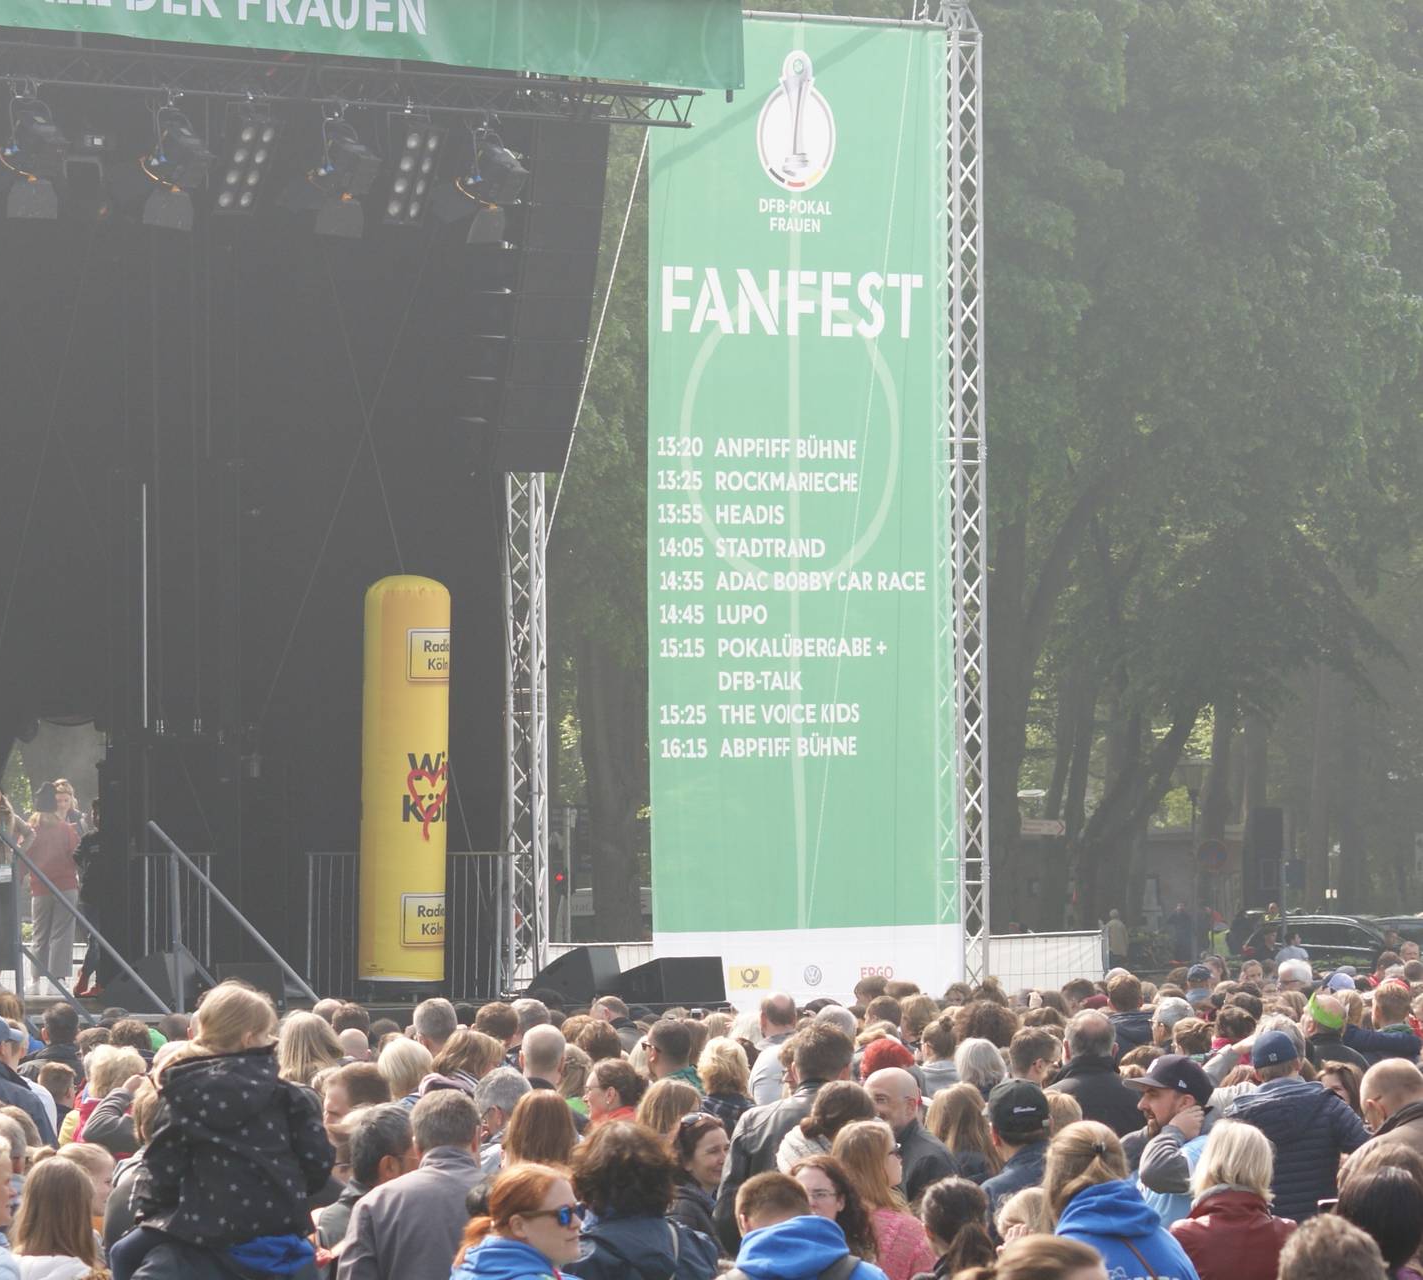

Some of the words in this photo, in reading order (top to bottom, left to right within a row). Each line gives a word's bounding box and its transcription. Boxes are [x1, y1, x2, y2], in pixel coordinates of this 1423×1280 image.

[759, 198, 832, 215] DFB-POKAL
[770, 217, 821, 232] FRAUEN
[662, 266, 923, 338] FANFEST
[657, 436, 703, 457] 13:20
[714, 438, 790, 458] ANPFIFF
[796, 435, 857, 459] BÜHNE
[657, 470, 703, 490] 13:25
[715, 471, 858, 492] ROCKMARIECHE
[657, 504, 703, 524] 13:55
[716, 504, 785, 525] HEADIS
[658, 537, 704, 557] 14:05
[715, 537, 826, 558] STADTRAND
[660, 571, 704, 591] 14:35
[716, 571, 768, 591] ADAC
[773, 571, 833, 592] BOBBY
[838, 571, 873, 592] CAR
[877, 571, 926, 591] RACE
[659, 604, 704, 624] 14:45
[717, 604, 768, 625] LUPO
[423, 638, 449, 653] Rad
[659, 638, 705, 658] 15:15
[717, 634, 872, 658] POKALÜBERGABE
[719, 671, 803, 691] DFB-TALK
[659, 704, 706, 725] 15:25
[719, 704, 756, 724] THE
[761, 703, 817, 724] VOICE
[821, 703, 860, 723] KIDS
[660, 738, 707, 758] 16:15
[720, 737, 790, 758] ABPFIFF
[797, 733, 857, 757] BÜHNE
[402, 793, 447, 823] Köl
[417, 903, 445, 918] Rad
